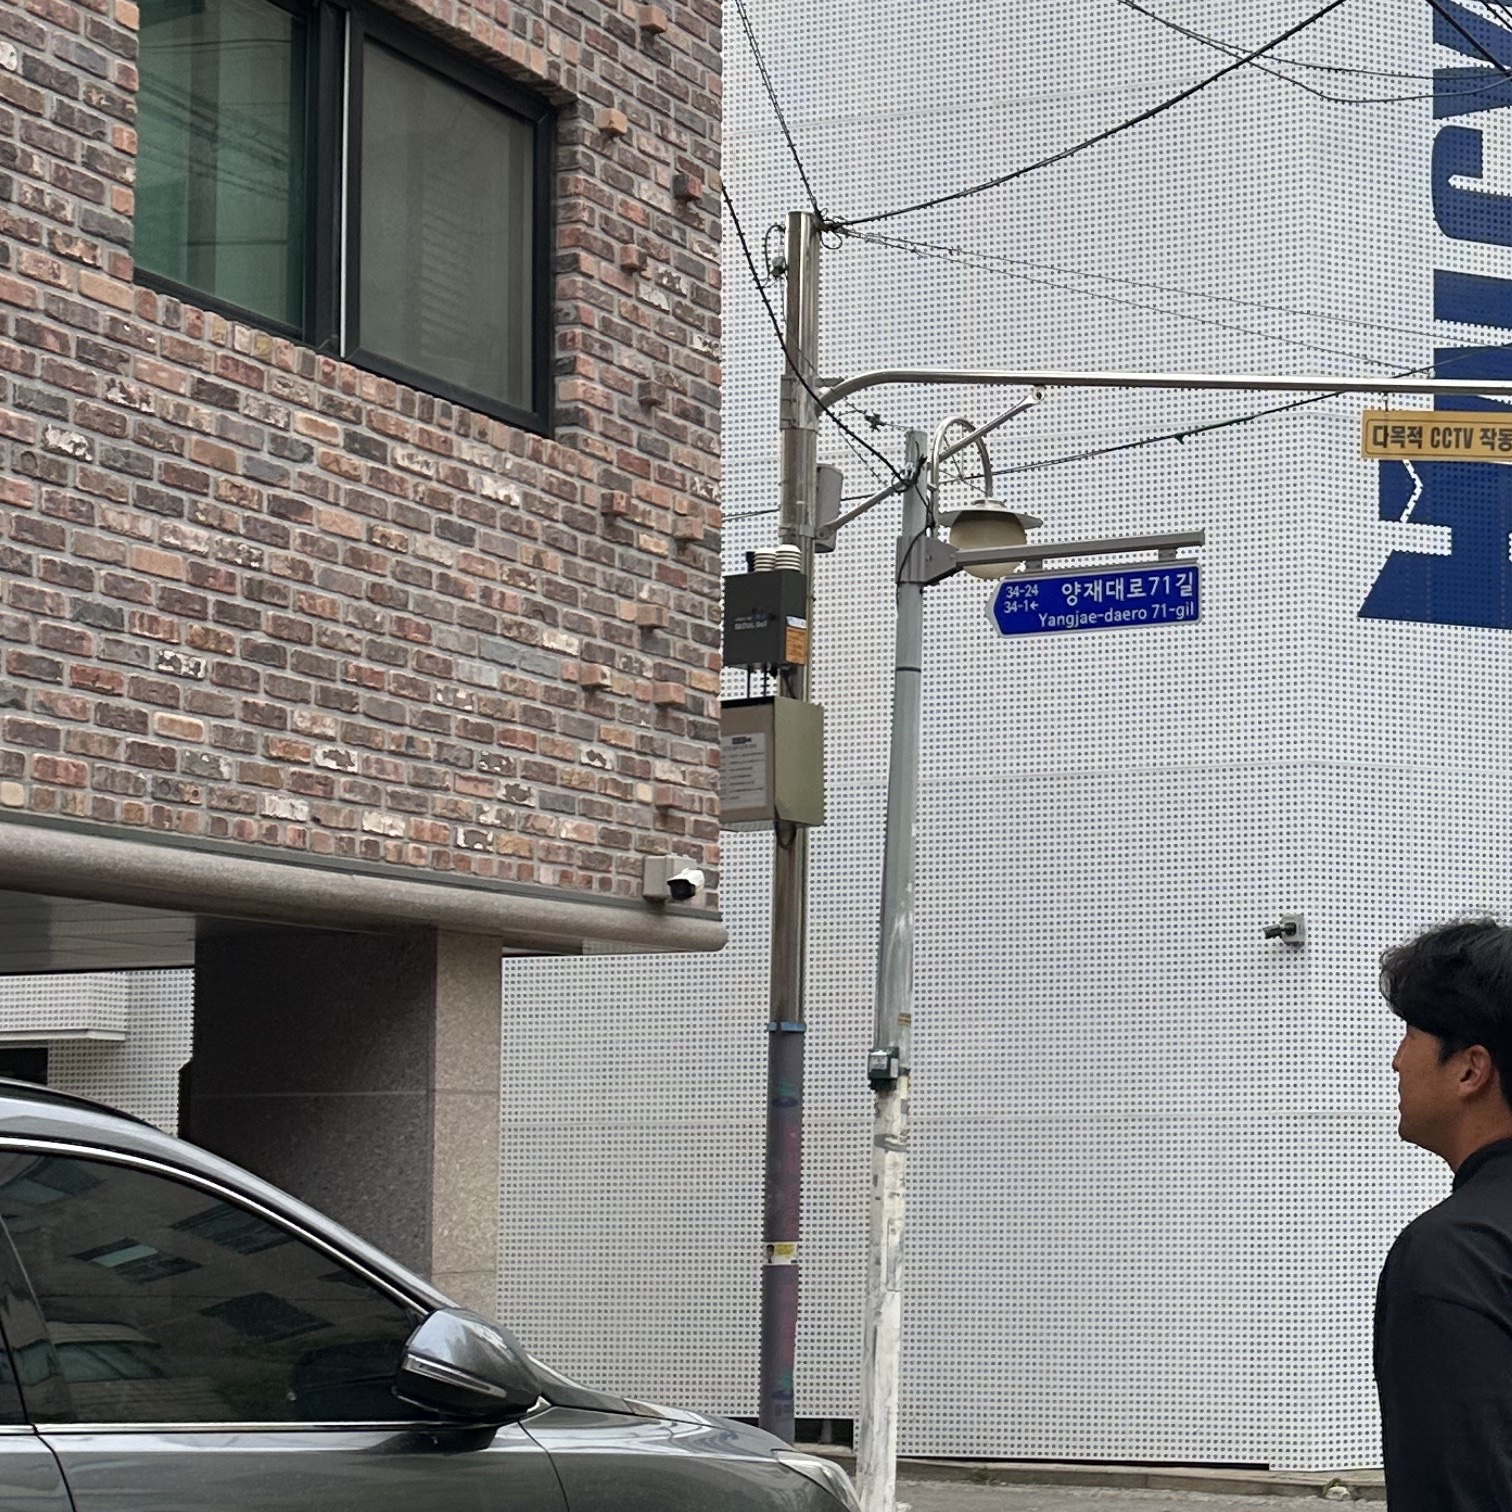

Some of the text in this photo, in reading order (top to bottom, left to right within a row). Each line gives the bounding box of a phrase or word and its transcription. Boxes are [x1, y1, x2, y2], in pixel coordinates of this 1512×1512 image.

[1371, 424, 1424, 450] 다목적
[1430, 426, 1474, 450] CCTV
[1005, 583, 1040, 599] 34-24
[1003, 599, 1030, 614] 34-1
[1038, 600, 1195, 629] Yangjae-daero 71-gil
